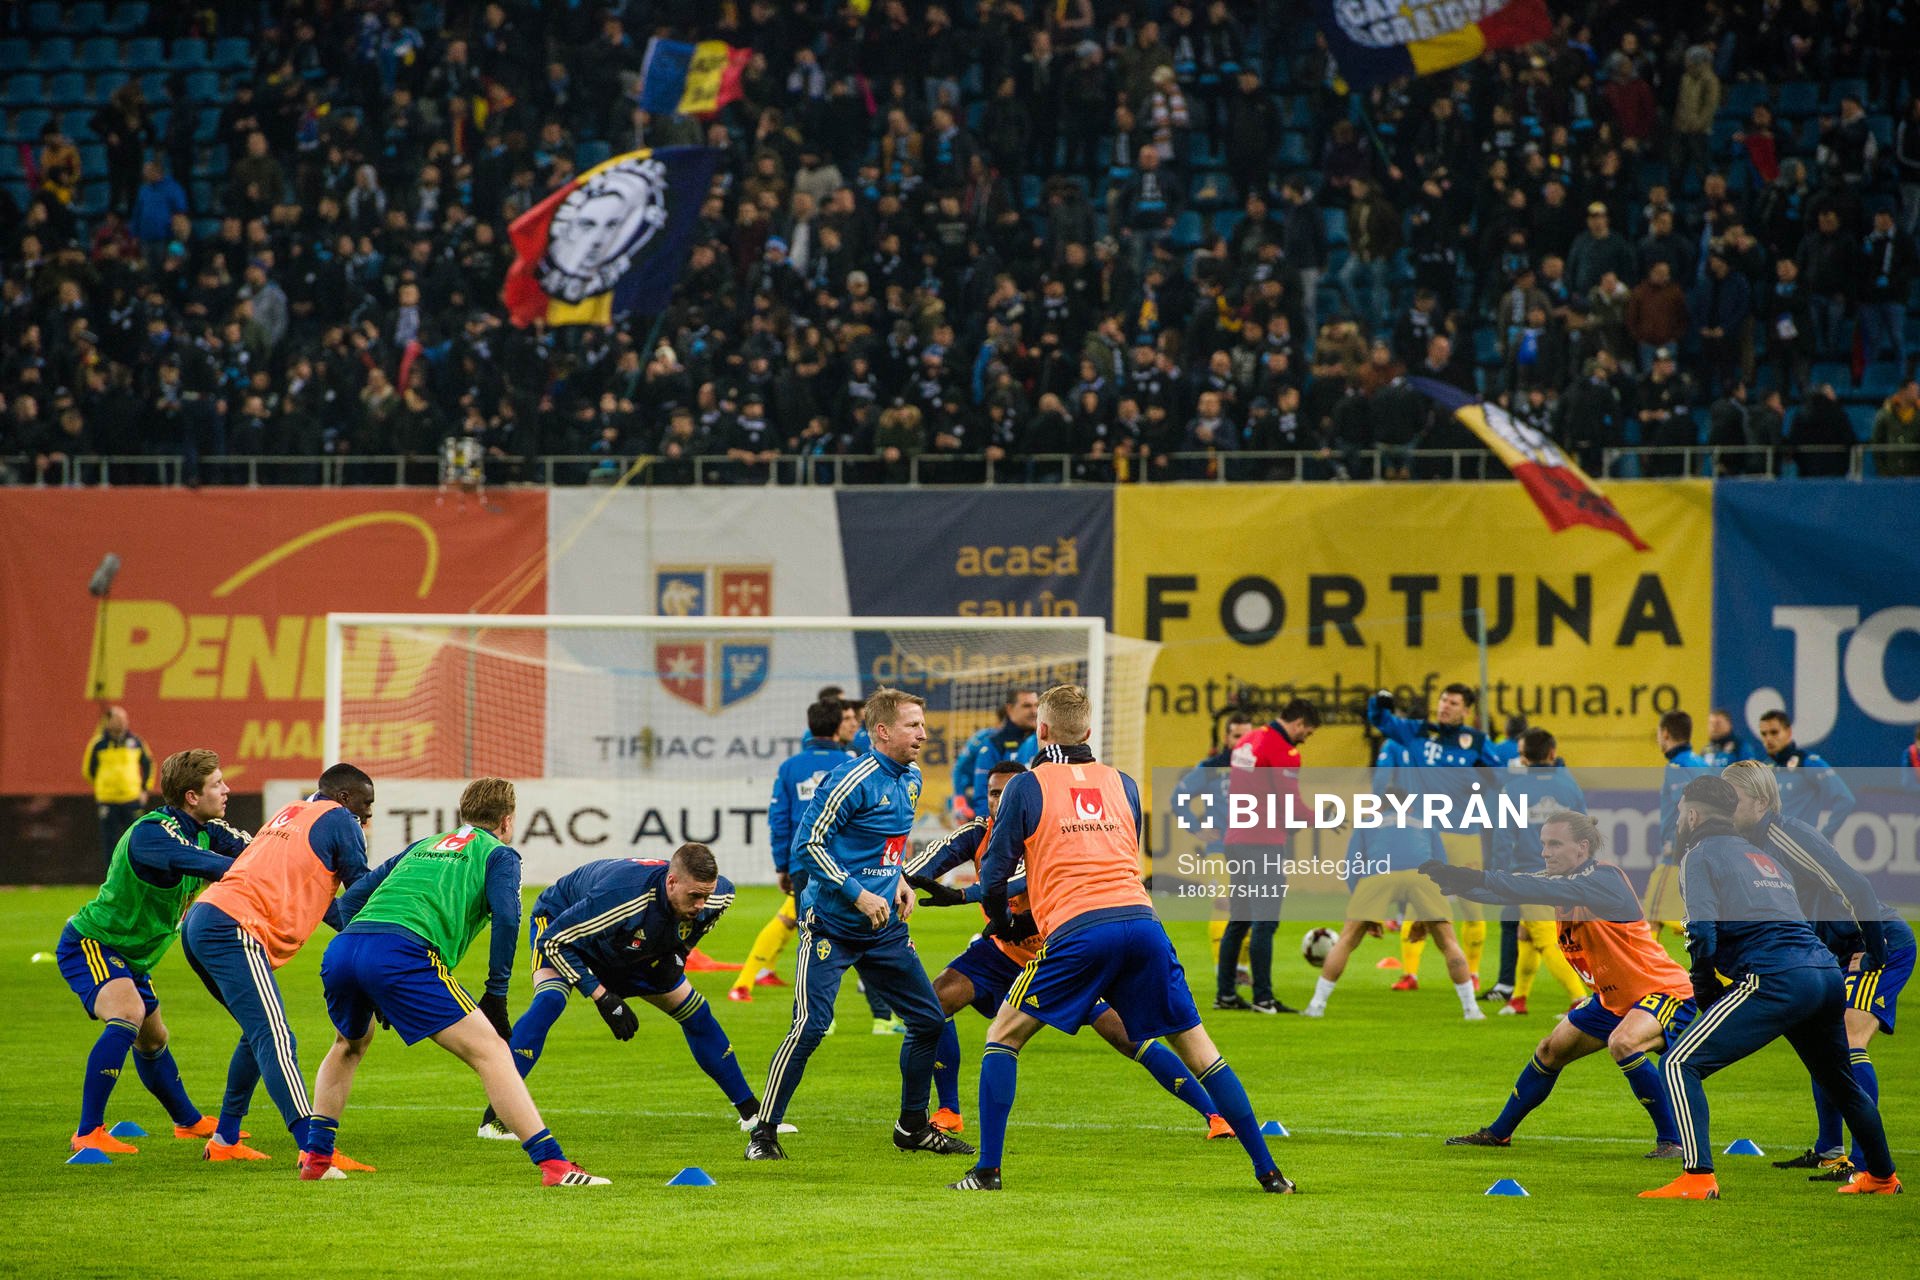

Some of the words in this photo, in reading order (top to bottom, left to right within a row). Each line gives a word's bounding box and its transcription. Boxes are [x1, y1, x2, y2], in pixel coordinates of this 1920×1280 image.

[956, 536, 1080, 577] acasă
[1144, 573, 1683, 648] FORTUNA
[85, 599, 451, 699] PENNY
[388, 807, 609, 845] TIAC
[1061, 824, 1103, 834] SVENSKA
